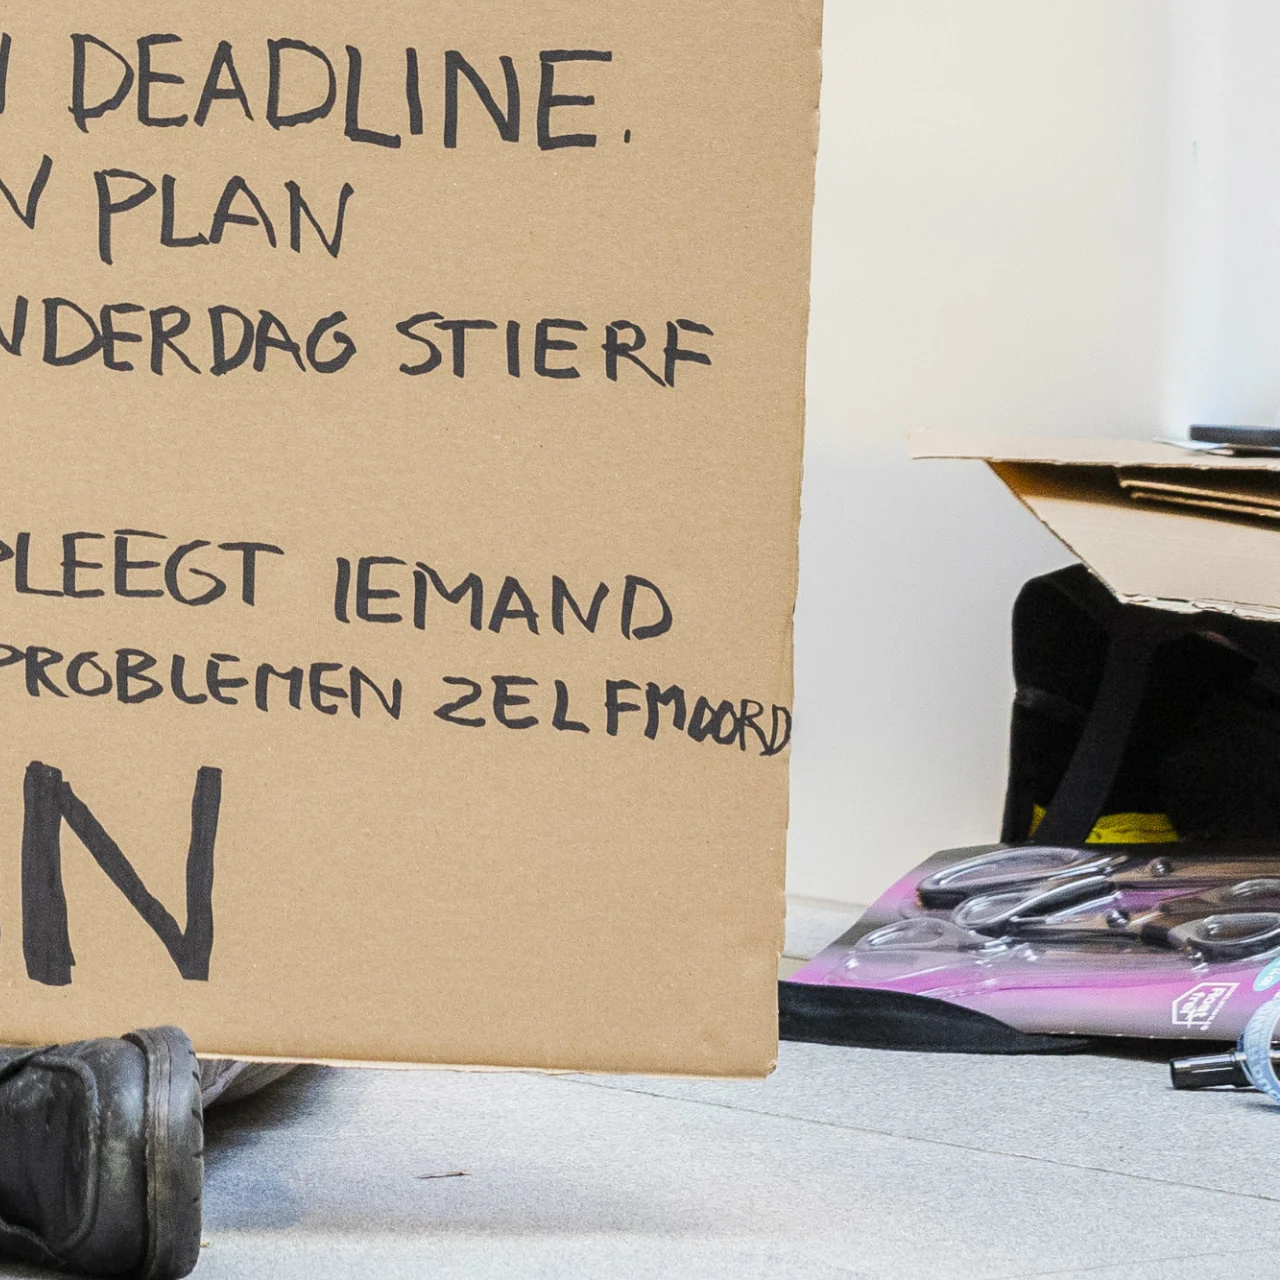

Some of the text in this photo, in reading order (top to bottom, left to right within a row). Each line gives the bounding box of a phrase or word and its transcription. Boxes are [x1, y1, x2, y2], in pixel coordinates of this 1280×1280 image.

[68, 34, 630, 150] DEADLINE.
[94, 169, 354, 265] PLAN
[396, 312, 713, 387] STIERF
[335, 557, 672, 640] IEMAND
[434, 676, 793, 756] ZELFMOORD
